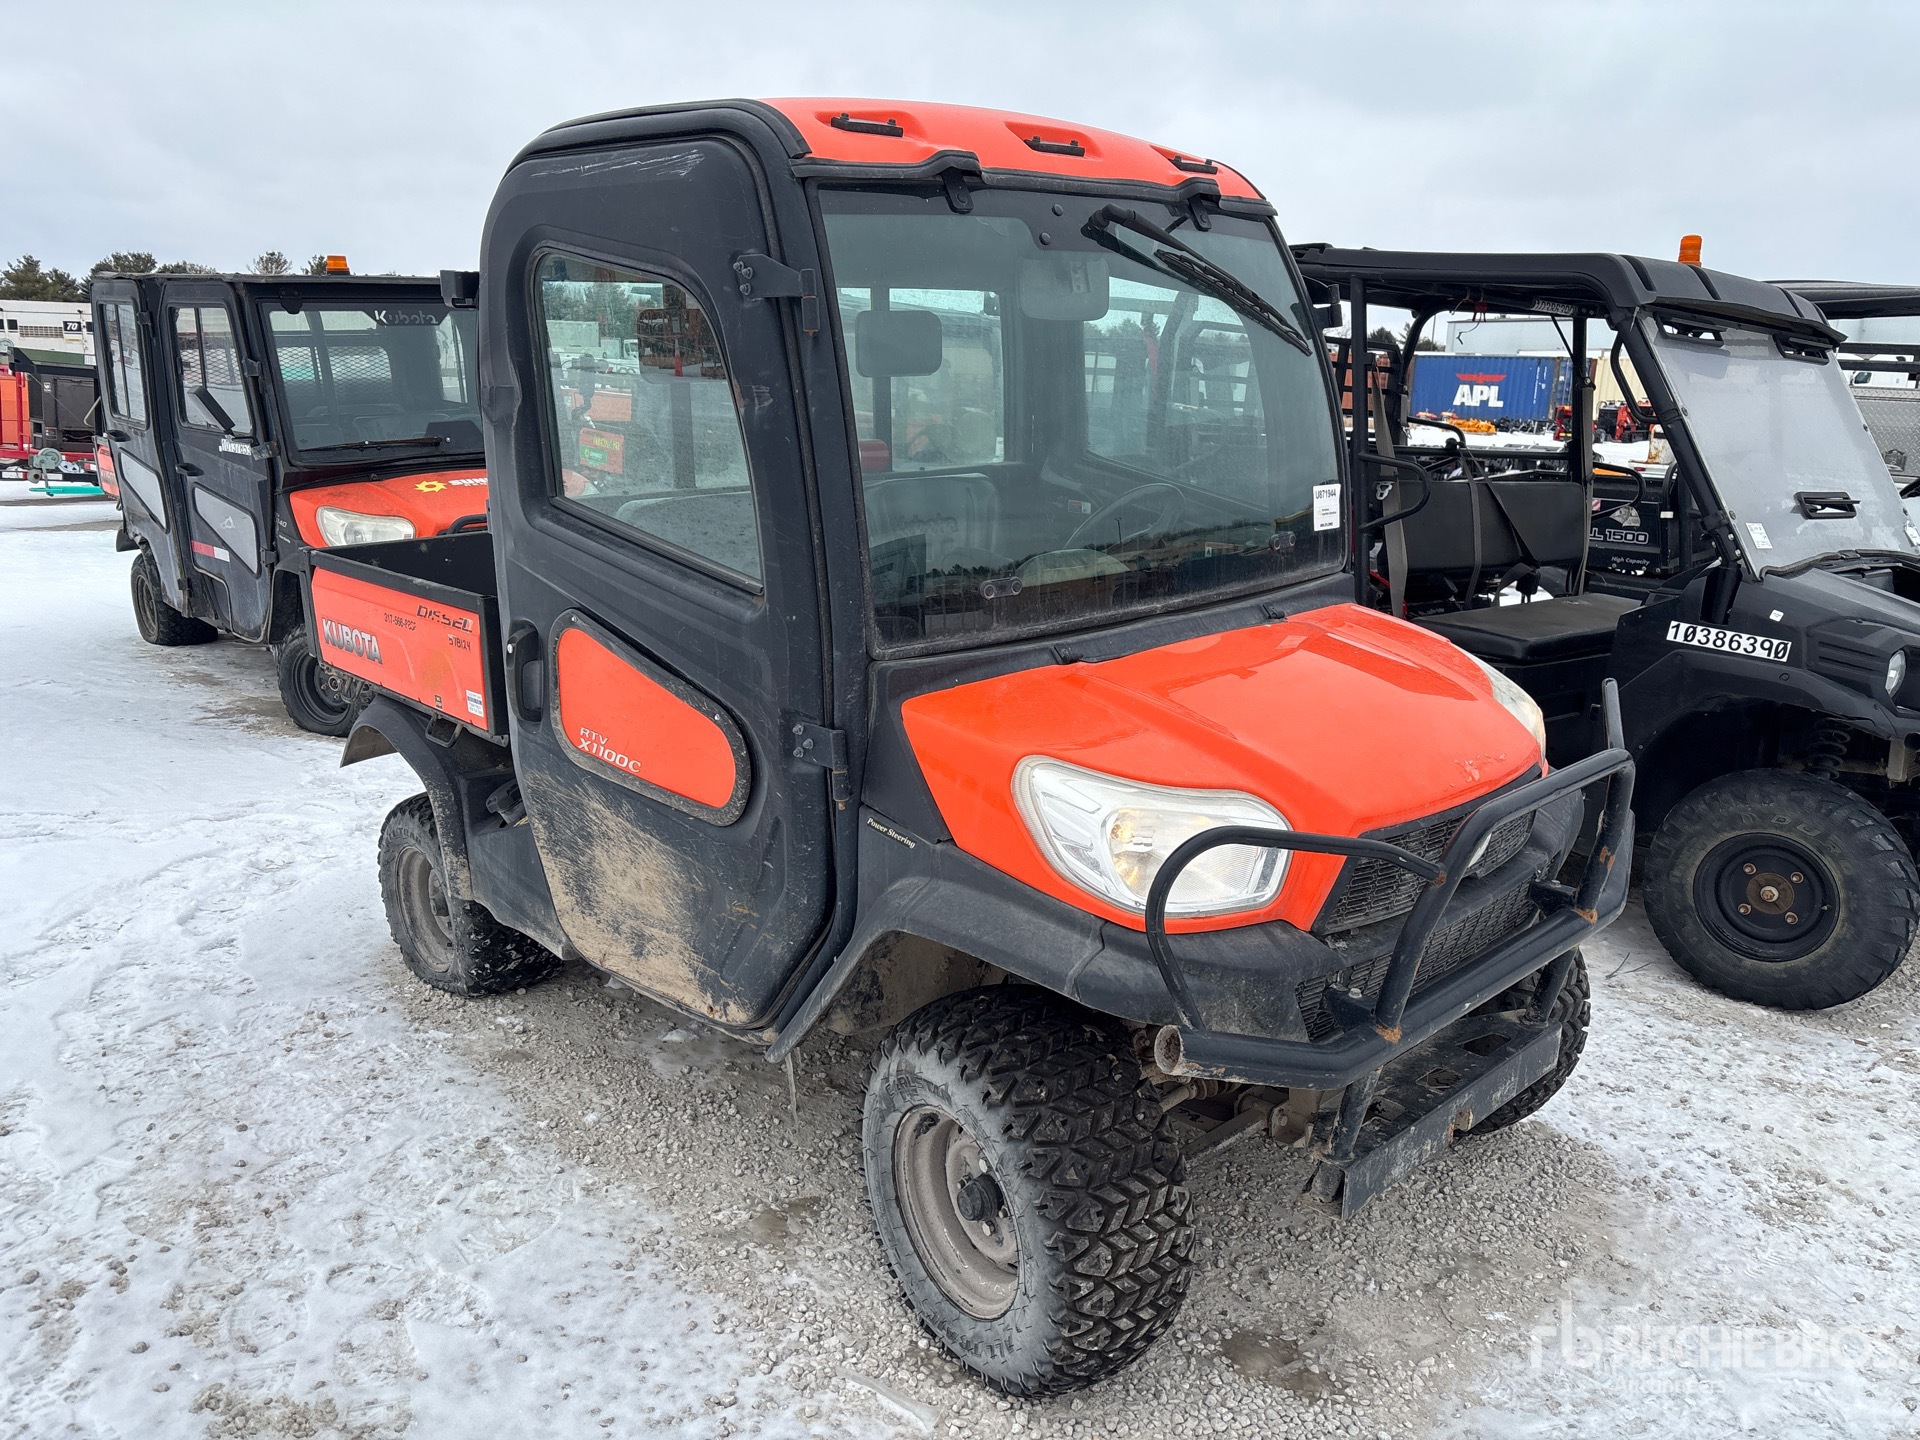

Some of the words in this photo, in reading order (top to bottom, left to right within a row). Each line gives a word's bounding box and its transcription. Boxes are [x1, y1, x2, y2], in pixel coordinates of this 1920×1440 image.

[374, 310, 439, 324] Kubota
[66, 322, 79, 331] 70
[1453, 384, 1504, 407] APL
[1315, 488, 1337, 499] U871944
[1605, 528, 1649, 545] 1500
[1611, 556, 1625, 564] High
[1625, 558, 1650, 566] Capacity
[321, 618, 384, 665] KUBOTA
[1671, 622, 1790, 660] 10386390
[580, 727, 608, 744] RTV
[578, 738, 642, 773] X1100C
[866, 817, 888, 833] Power
[886, 828, 916, 850] Steering
